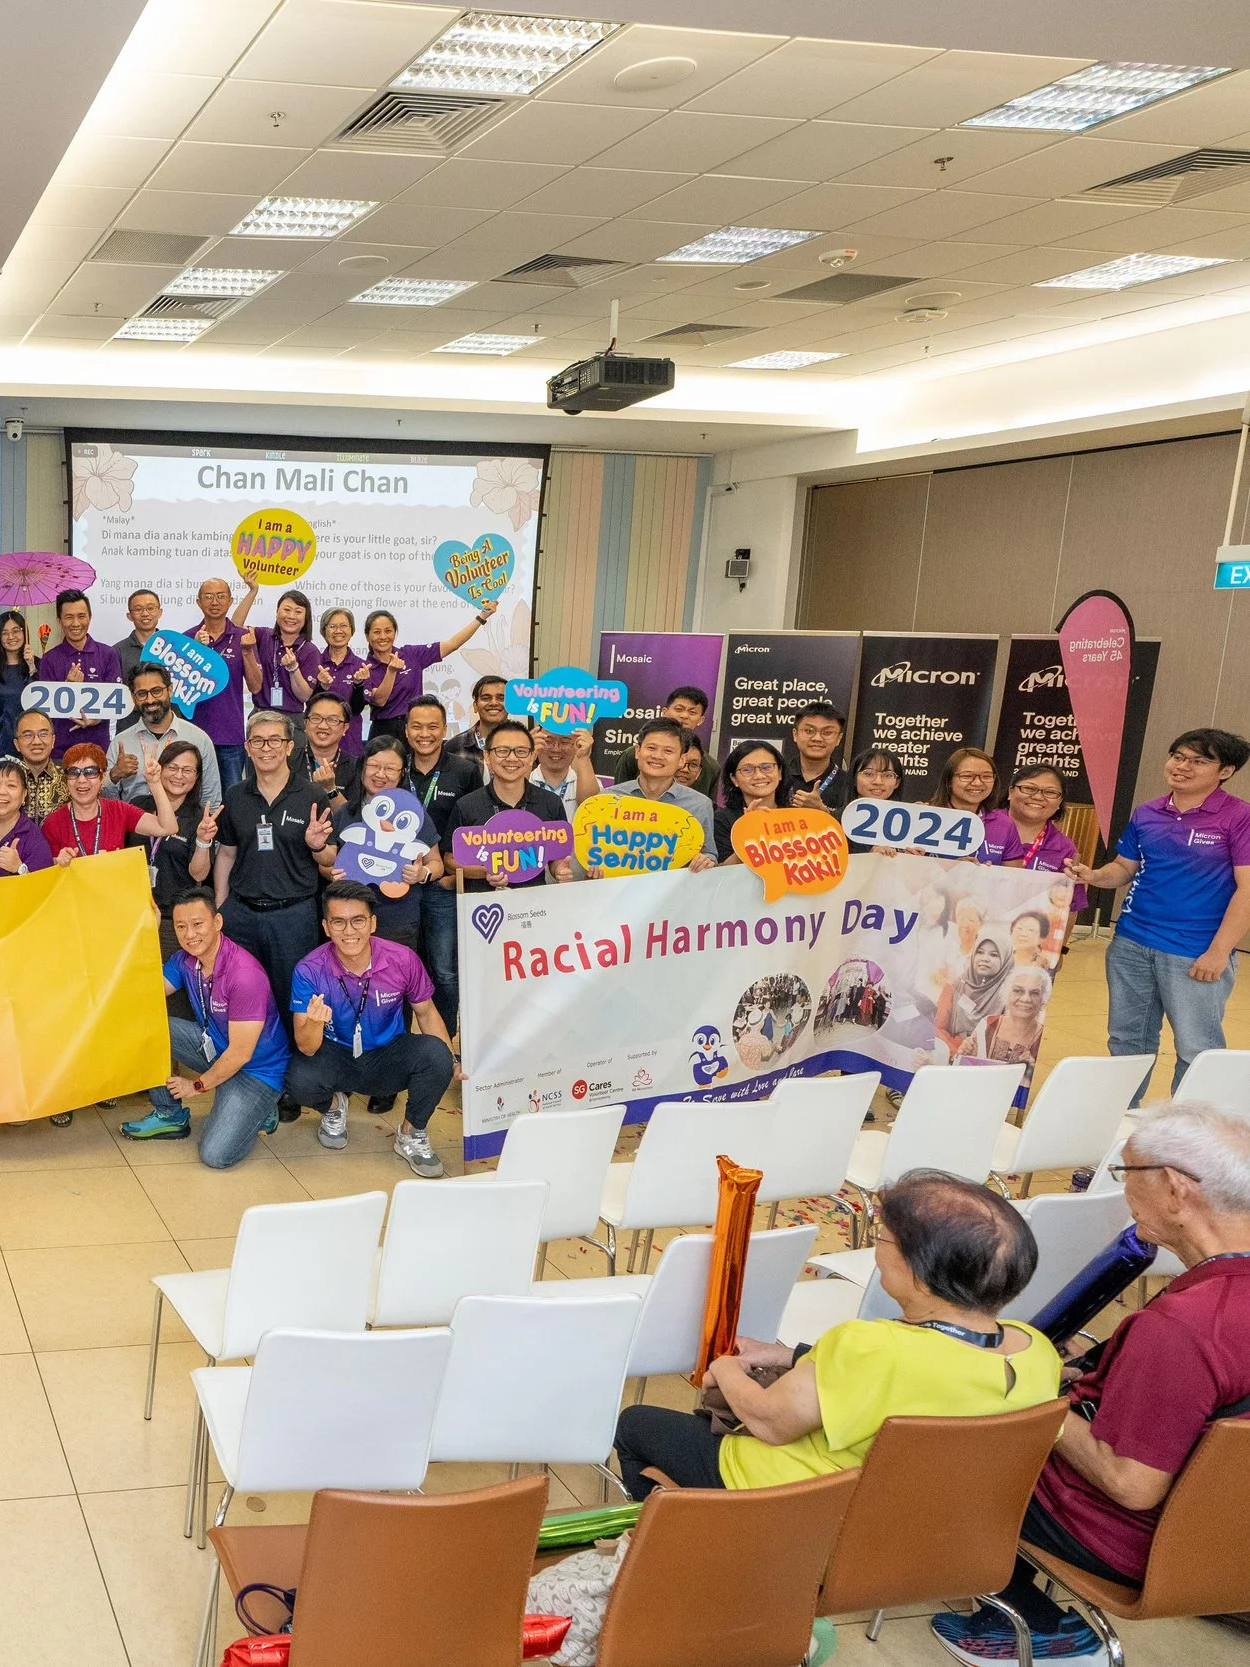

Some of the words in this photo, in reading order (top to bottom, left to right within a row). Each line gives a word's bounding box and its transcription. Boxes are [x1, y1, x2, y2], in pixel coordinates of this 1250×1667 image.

[198, 465, 265, 490] Chan
[275, 467, 334, 492] Mali
[343, 469, 408, 493] Chan
[258, 519, 263, 529] I
[265, 521, 283, 532] am
[285, 524, 292, 534] a
[237, 531, 312, 564] HAPPY
[333, 534, 340, 543] is
[344, 536, 366, 545] your
[369, 534, 390, 544] little
[394, 535, 418, 546] goat,
[421, 536, 437, 545] sir?
[449, 548, 480, 569] Being
[481, 539, 494, 555] A
[243, 559, 299, 577] Volunteer
[445, 551, 510, 590] Volunteer
[467, 585, 482, 601] Is
[484, 572, 508, 592] Cool
[315, 597, 331, 607] the
[334, 597, 372, 609] Tanjong
[376, 597, 406, 609] flower
[410, 599, 419, 608] at
[423, 598, 438, 608] the
[441, 599, 457, 609] end
[735, 644, 770, 654] Micron
[149, 636, 216, 695] Blossom
[181, 642, 191, 652] I
[187, 648, 204, 664] am
[205, 663, 213, 673] a
[617, 654, 652, 663] Mosaic
[871, 661, 977, 687] Micron
[513, 683, 620, 703] Volunteering
[735, 677, 778, 690] Great
[782, 678, 828, 694] place,
[30, 686, 126, 715] 2024
[732, 695, 773, 709] great
[526, 698, 539, 714] is
[540, 701, 596, 725] FUN!
[731, 712, 772, 726] great
[875, 712, 948, 729] Together
[873, 729, 897, 739] we
[901, 728, 963, 742] achieve
[1020, 729, 1045, 740] we
[1018, 741, 1082, 755] greater
[286, 815, 305, 825] Mosaic
[613, 808, 619, 819] I
[622, 809, 645, 821] am
[650, 812, 658, 822] a
[764, 822, 770, 835] I
[773, 821, 796, 835] am
[799, 819, 808, 830] a
[850, 803, 973, 851] 2024
[461, 827, 568, 847] Volunteering
[592, 824, 678, 855] Happy
[1194, 832, 1221, 841] Micron
[744, 830, 843, 869] Blossom
[476, 845, 489, 862] is
[492, 845, 545, 874] FUN!
[587, 847, 674, 872] Senior
[783, 853, 841, 886] Kaki!
[508, 911, 529, 921] Blossom
[530, 909, 547, 918] Seeds
[503, 918, 633, 981] Racial
[645, 907, 826, 961] Harmony
[840, 898, 920, 945] Day
[627, 1051, 649, 1060] Supported
[586, 1060, 606, 1068] Operator
[537, 1070, 555, 1078] Member
[475, 1084, 492, 1092] Sector
[493, 1077, 525, 1089] Administrator
[573, 1085, 586, 1094] SG
[589, 1080, 612, 1092] Cares
[730, 1088, 750, 1100] with
[752, 1080, 769, 1093] Love
[542, 1090, 562, 1101] NCSS
[589, 1090, 608, 1098] Volunteer
[932, 1322, 966, 1336] Together
